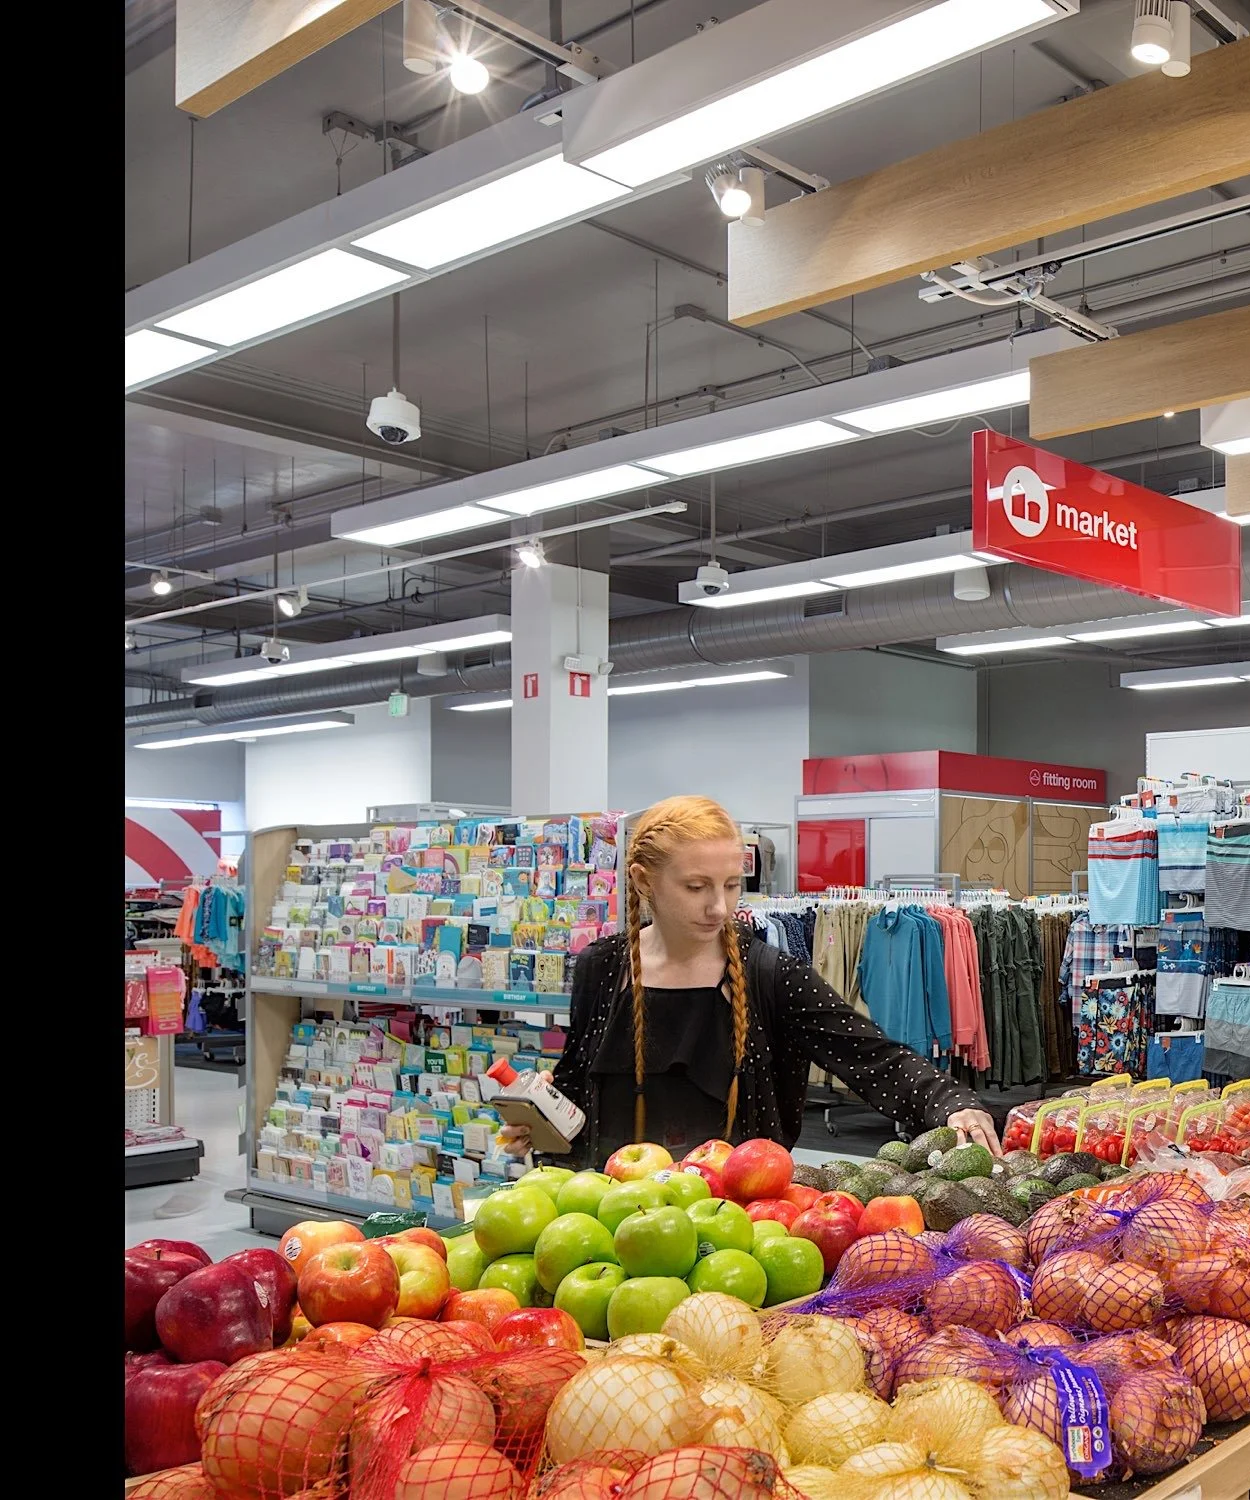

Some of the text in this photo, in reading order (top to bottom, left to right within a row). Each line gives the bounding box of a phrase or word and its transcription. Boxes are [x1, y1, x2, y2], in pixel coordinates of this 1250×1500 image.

[1056, 501, 1138, 549] market
[1043, 772, 1097, 791] fitting room
